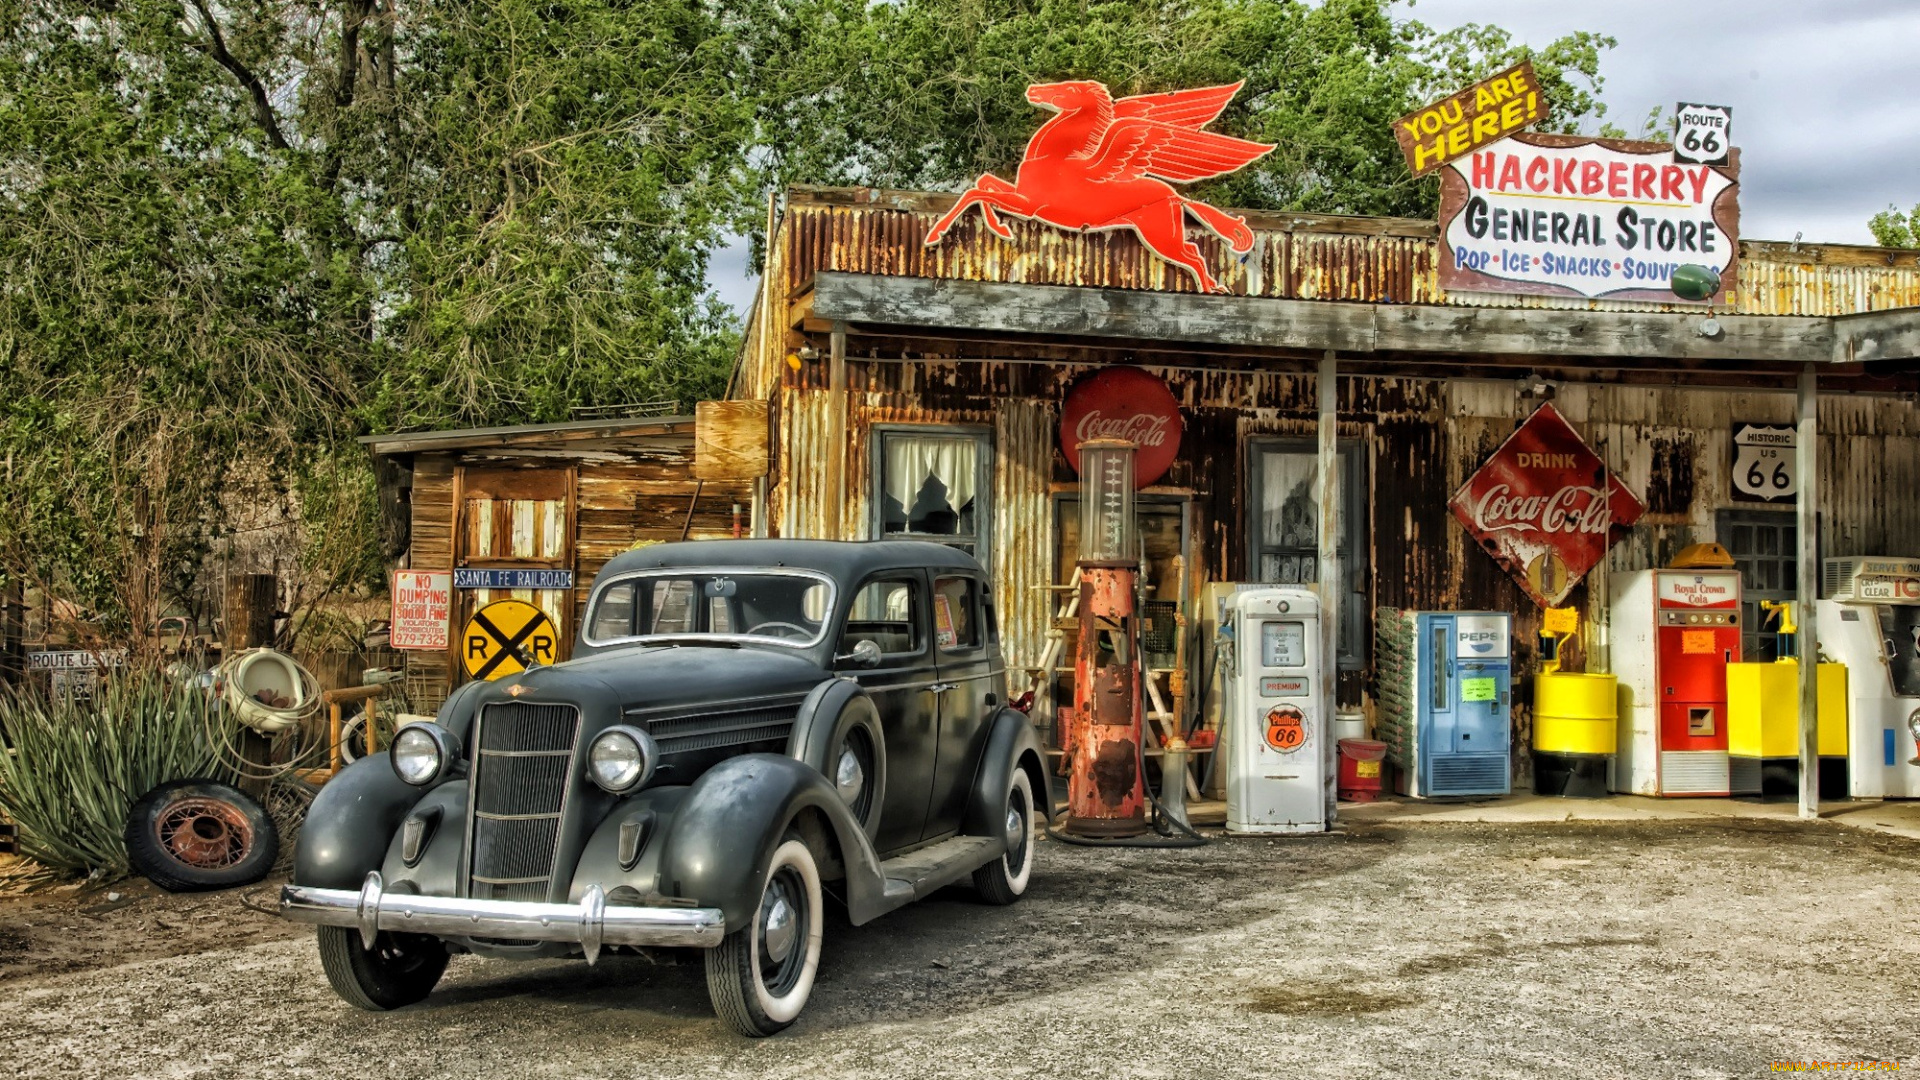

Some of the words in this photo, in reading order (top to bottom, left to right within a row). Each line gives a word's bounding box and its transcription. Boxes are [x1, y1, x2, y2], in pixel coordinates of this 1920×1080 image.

[1403, 99, 1463, 141] YOU
[1476, 70, 1529, 112] ARE
[1683, 113, 1723, 128] ROUTE
[1415, 91, 1537, 171] HERE!
[1683, 129, 1720, 153] 66
[1472, 151, 1711, 204] HACKBERRY
[1465, 196, 1606, 247] GENERAL
[1616, 206, 1715, 253] STORE
[1076, 410, 1170, 447] Coca-Cola
[1747, 433, 1790, 443] HISTORIC
[1517, 453, 1577, 468] DRINK
[1761, 449, 1777, 458] US
[1747, 460, 1790, 490] 66
[1475, 484, 1618, 534] Coca-Cola
[1867, 563, 1898, 573] SERVE
[416, 575, 431, 589] NO
[459, 571, 491, 586] SANTA
[498, 571, 510, 586] FE
[517, 571, 568, 587] RAILROAD
[1861, 575, 1893, 587] CRYSTAL
[399, 589, 448, 604] DUMPING
[1674, 584, 1697, 595] Royal
[1700, 584, 1725, 594] Crown
[1865, 587, 1889, 597] CLEAR
[1689, 594, 1708, 604] Cola
[429, 609, 447, 620] FINE
[396, 634, 446, 645] 979-7325
[468, 636, 488, 659] R
[533, 636, 552, 659] R
[32, 653, 75, 667] ROUTE
[1270, 713, 1300, 728] Phillips
[1275, 728, 1297, 744] 66
